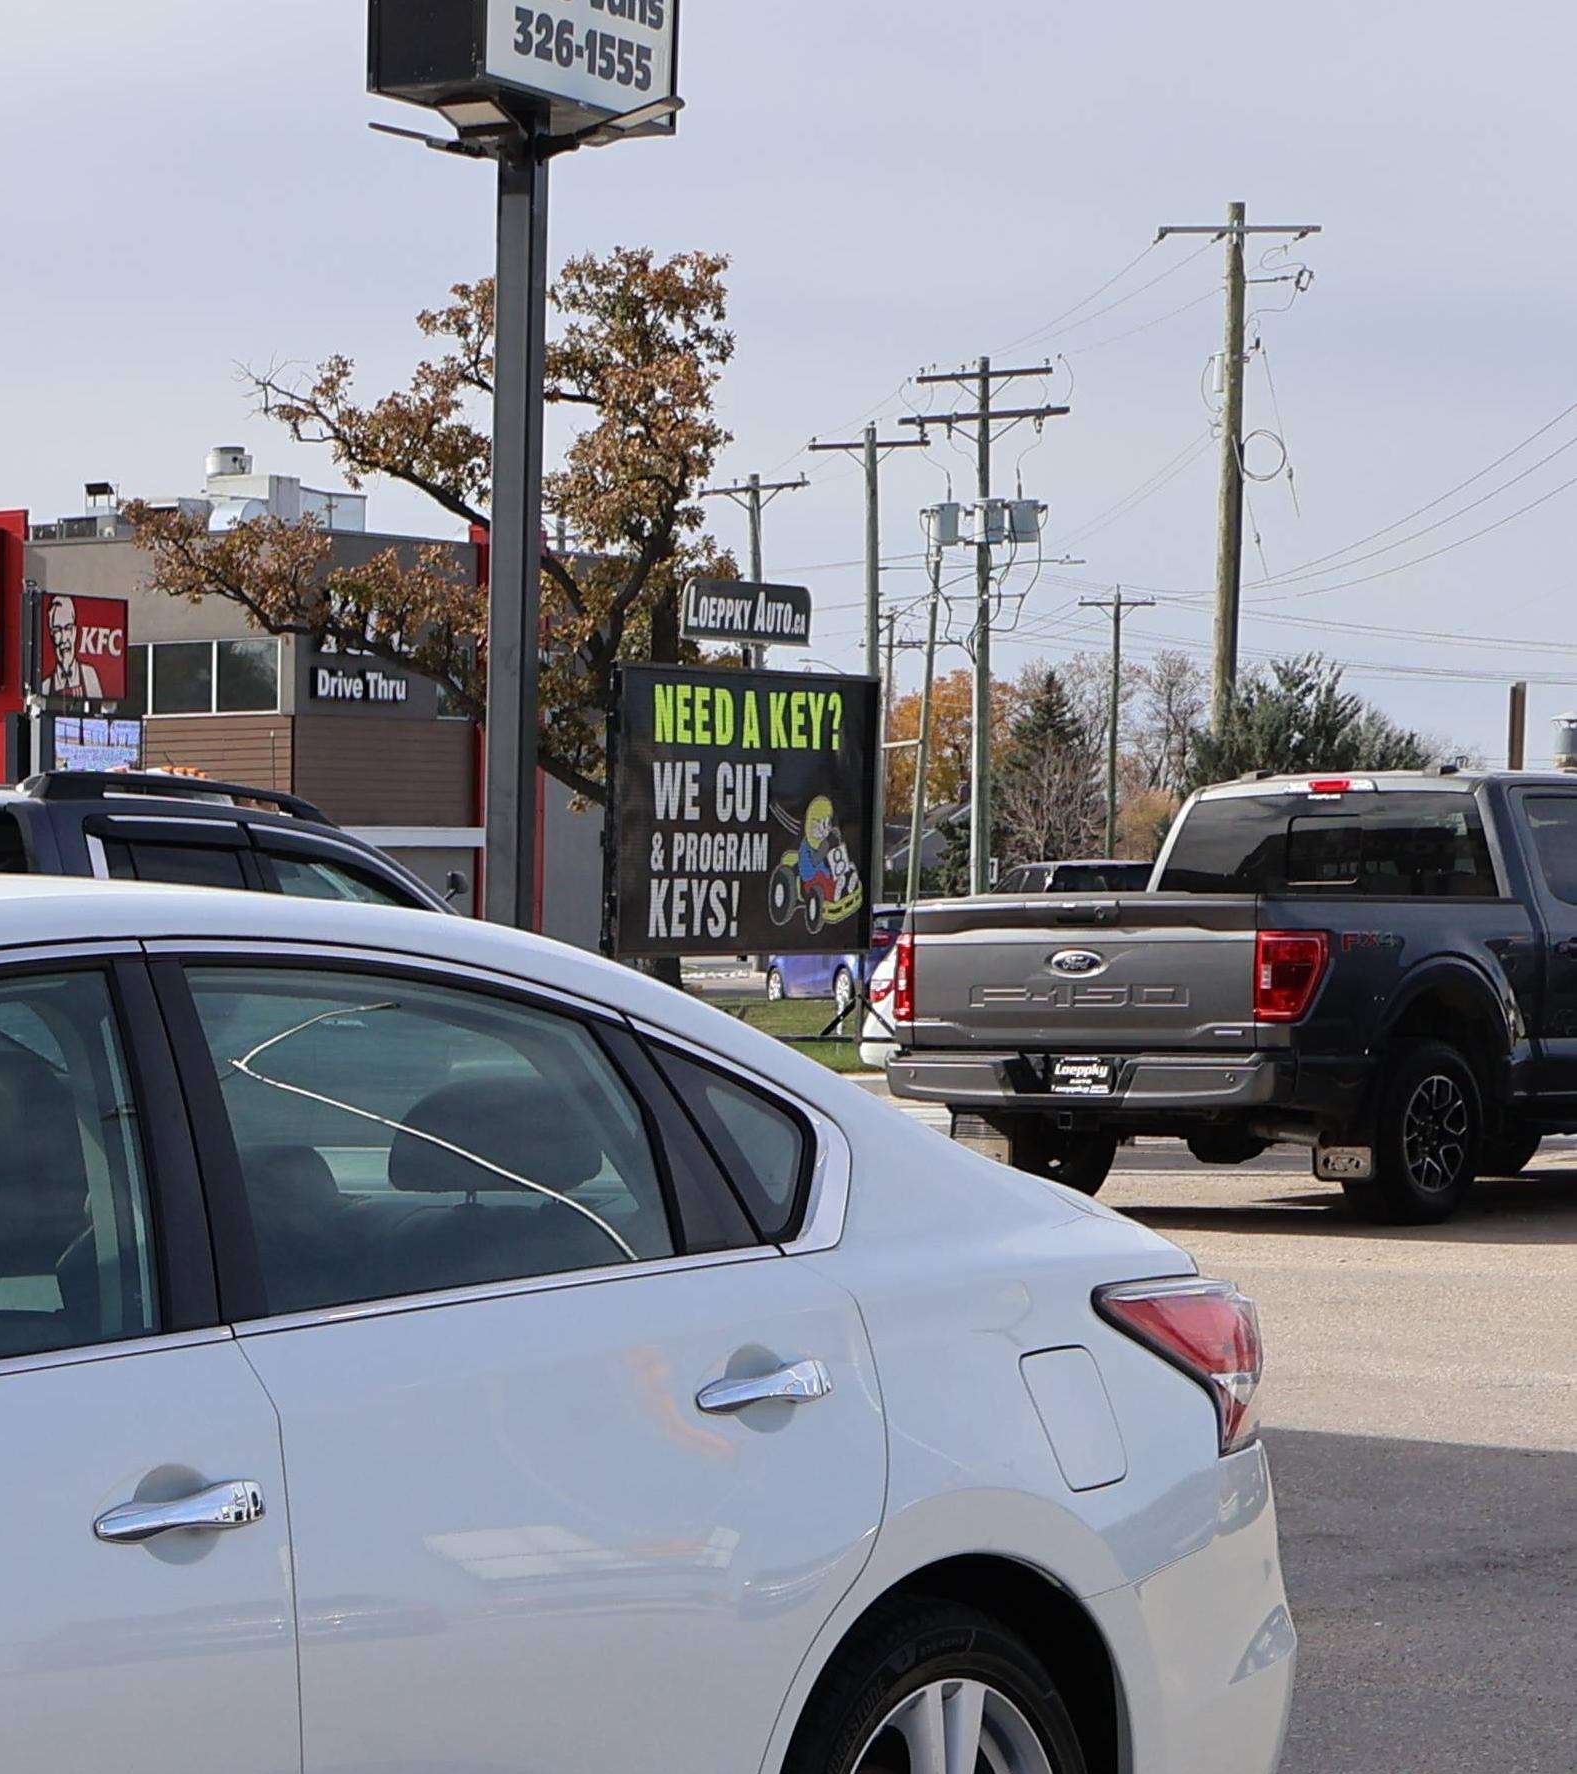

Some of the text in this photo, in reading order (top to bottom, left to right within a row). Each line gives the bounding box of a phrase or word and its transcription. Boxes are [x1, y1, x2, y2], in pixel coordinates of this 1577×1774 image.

[513, 6, 653, 91] 326-1555
[687, 585, 752, 631] LOEPPKY
[79, 626, 123, 656] KFC
[317, 668, 407, 700] Drive Thru
[654, 683, 843, 751] NEED A KEY?
[652, 760, 773, 823] WE CUT
[649, 831, 769, 873] & PROGRAM
[647, 878, 740, 939] KEYS!
[969, 984, 1190, 1008] F-150
